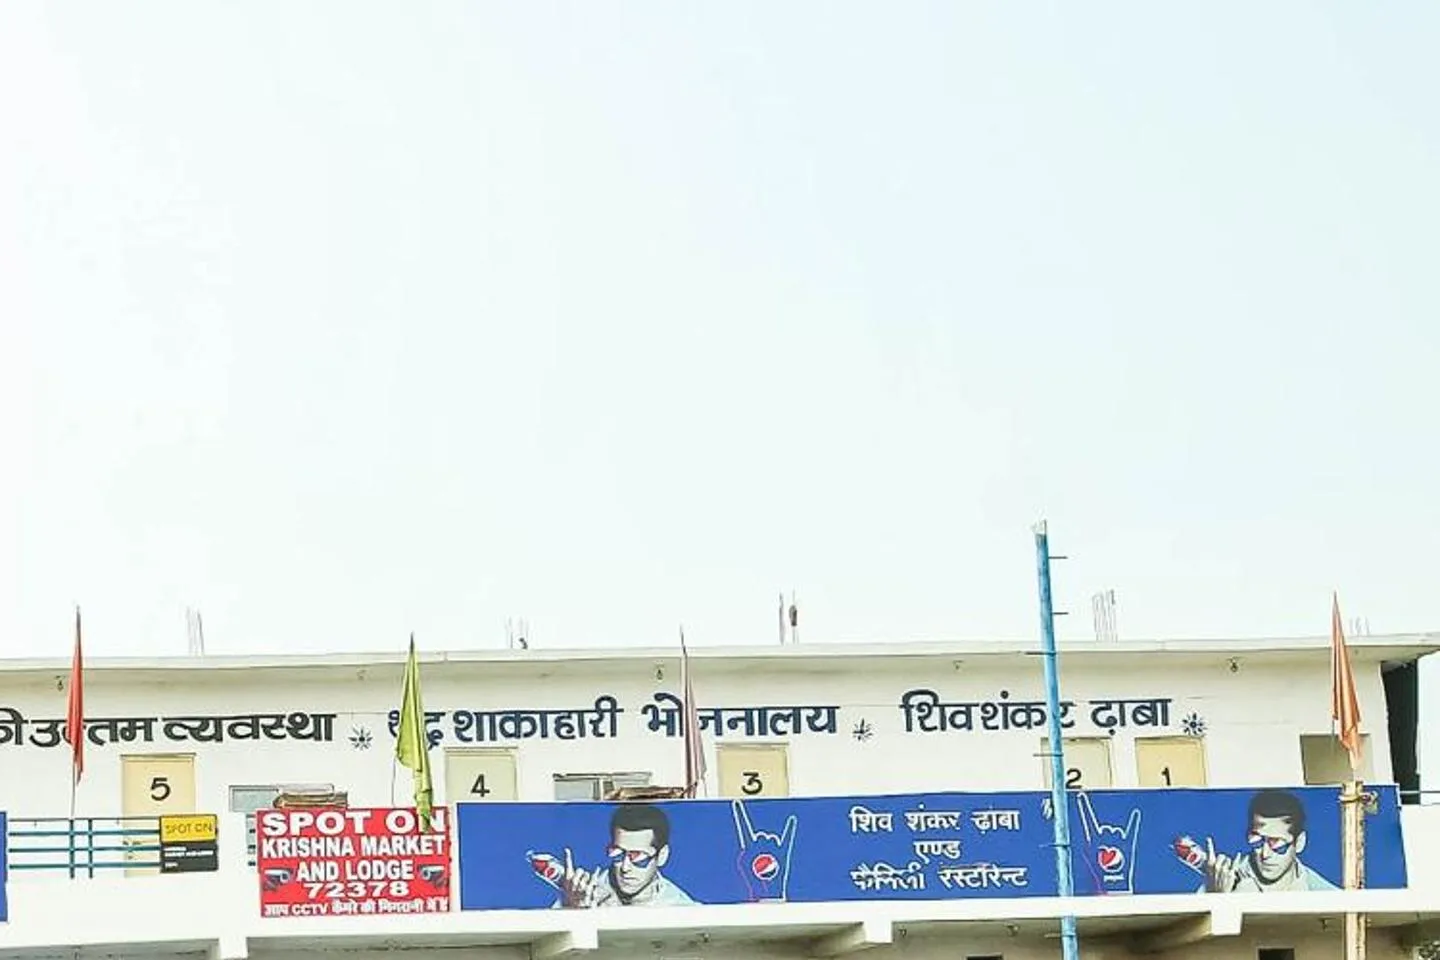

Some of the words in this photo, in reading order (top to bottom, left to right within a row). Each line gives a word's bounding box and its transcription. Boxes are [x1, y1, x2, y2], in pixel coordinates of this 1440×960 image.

[162, 711, 337, 743] व्यवस्था
[453, 695, 624, 743] शाकाहारी
[641, 692, 840, 738] भोजनालय
[470, 773, 490, 798] 4
[741, 771, 764, 795] 3
[1065, 768, 1083, 789] 2
[1161, 766, 1171, 787] 1
[150, 777, 171, 801] 5
[262, 809, 372, 837] SPOT
[385, 809, 446, 835] ON
[849, 805, 894, 833] शिव
[904, 803, 962, 833] शंकर
[261, 836, 356, 859] KRISHNA
[360, 834, 446, 857] MARKET
[296, 860, 340, 882] AND
[346, 859, 414, 881] LODGE
[303, 880, 410, 898] 72378
[292, 902, 329, 916] CCTV
